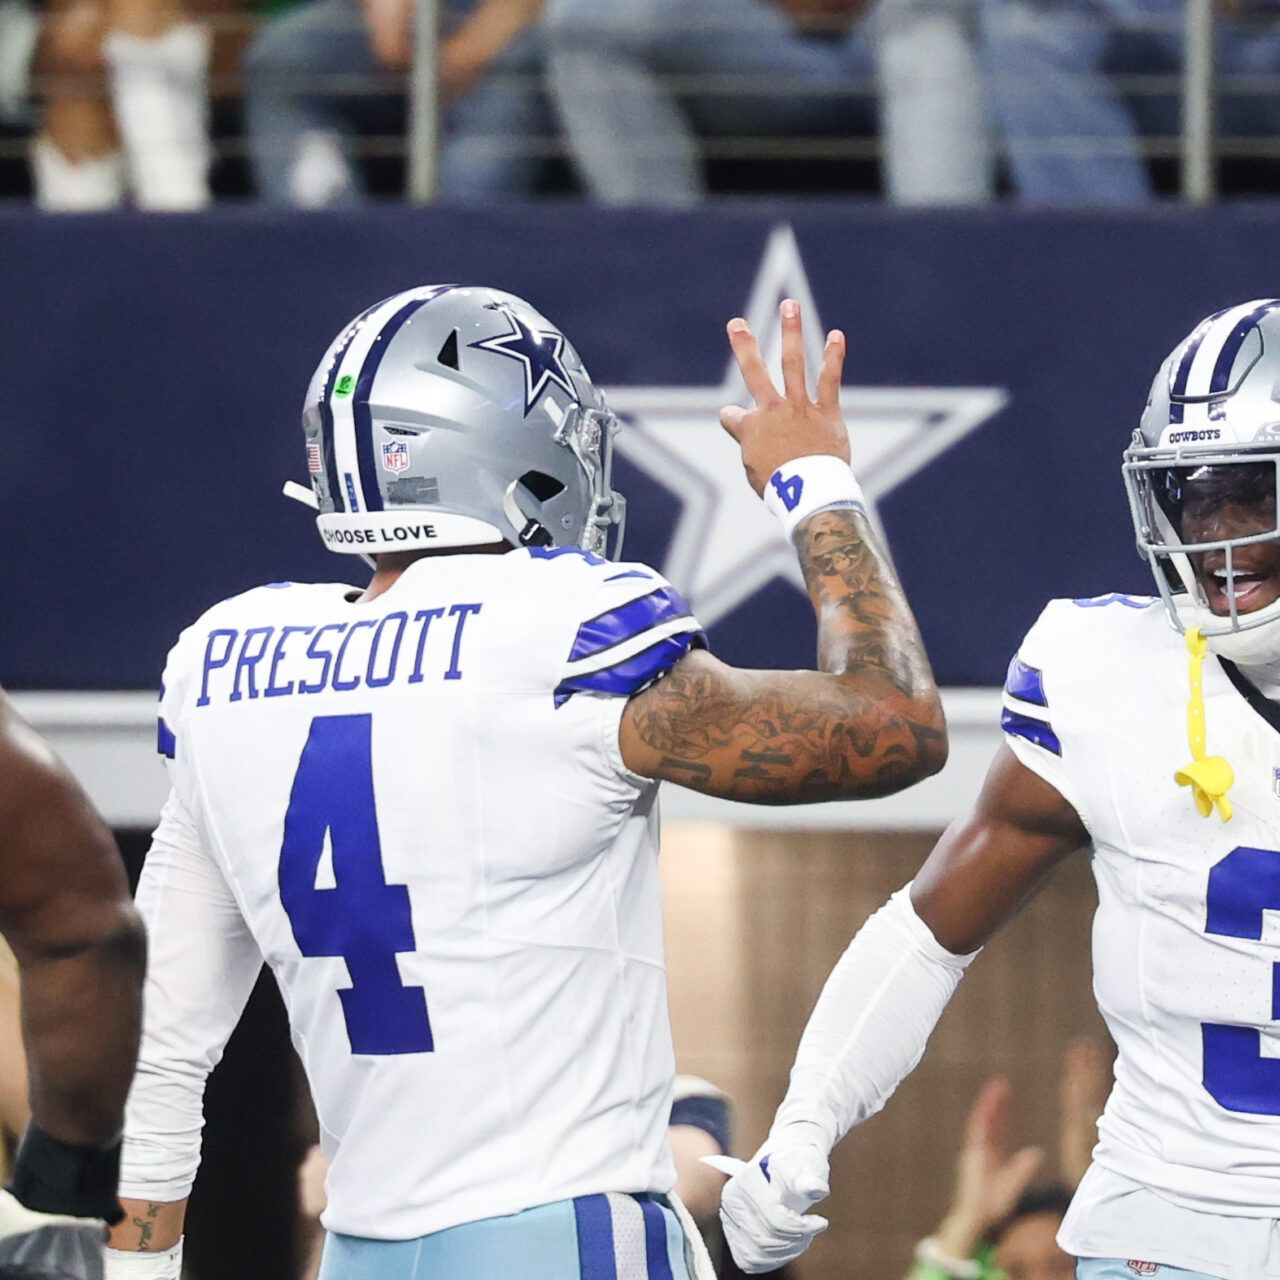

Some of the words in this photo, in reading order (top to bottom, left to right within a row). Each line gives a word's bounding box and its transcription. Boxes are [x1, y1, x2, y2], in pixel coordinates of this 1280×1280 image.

[1170, 429, 1221, 443] COWBOYS
[386, 454, 408, 468] NFL
[323, 528, 376, 544] CHOOSE
[381, 524, 438, 542] LOVE
[196, 602, 483, 708] PRESCOTT
[277, 712, 435, 1056] 4
